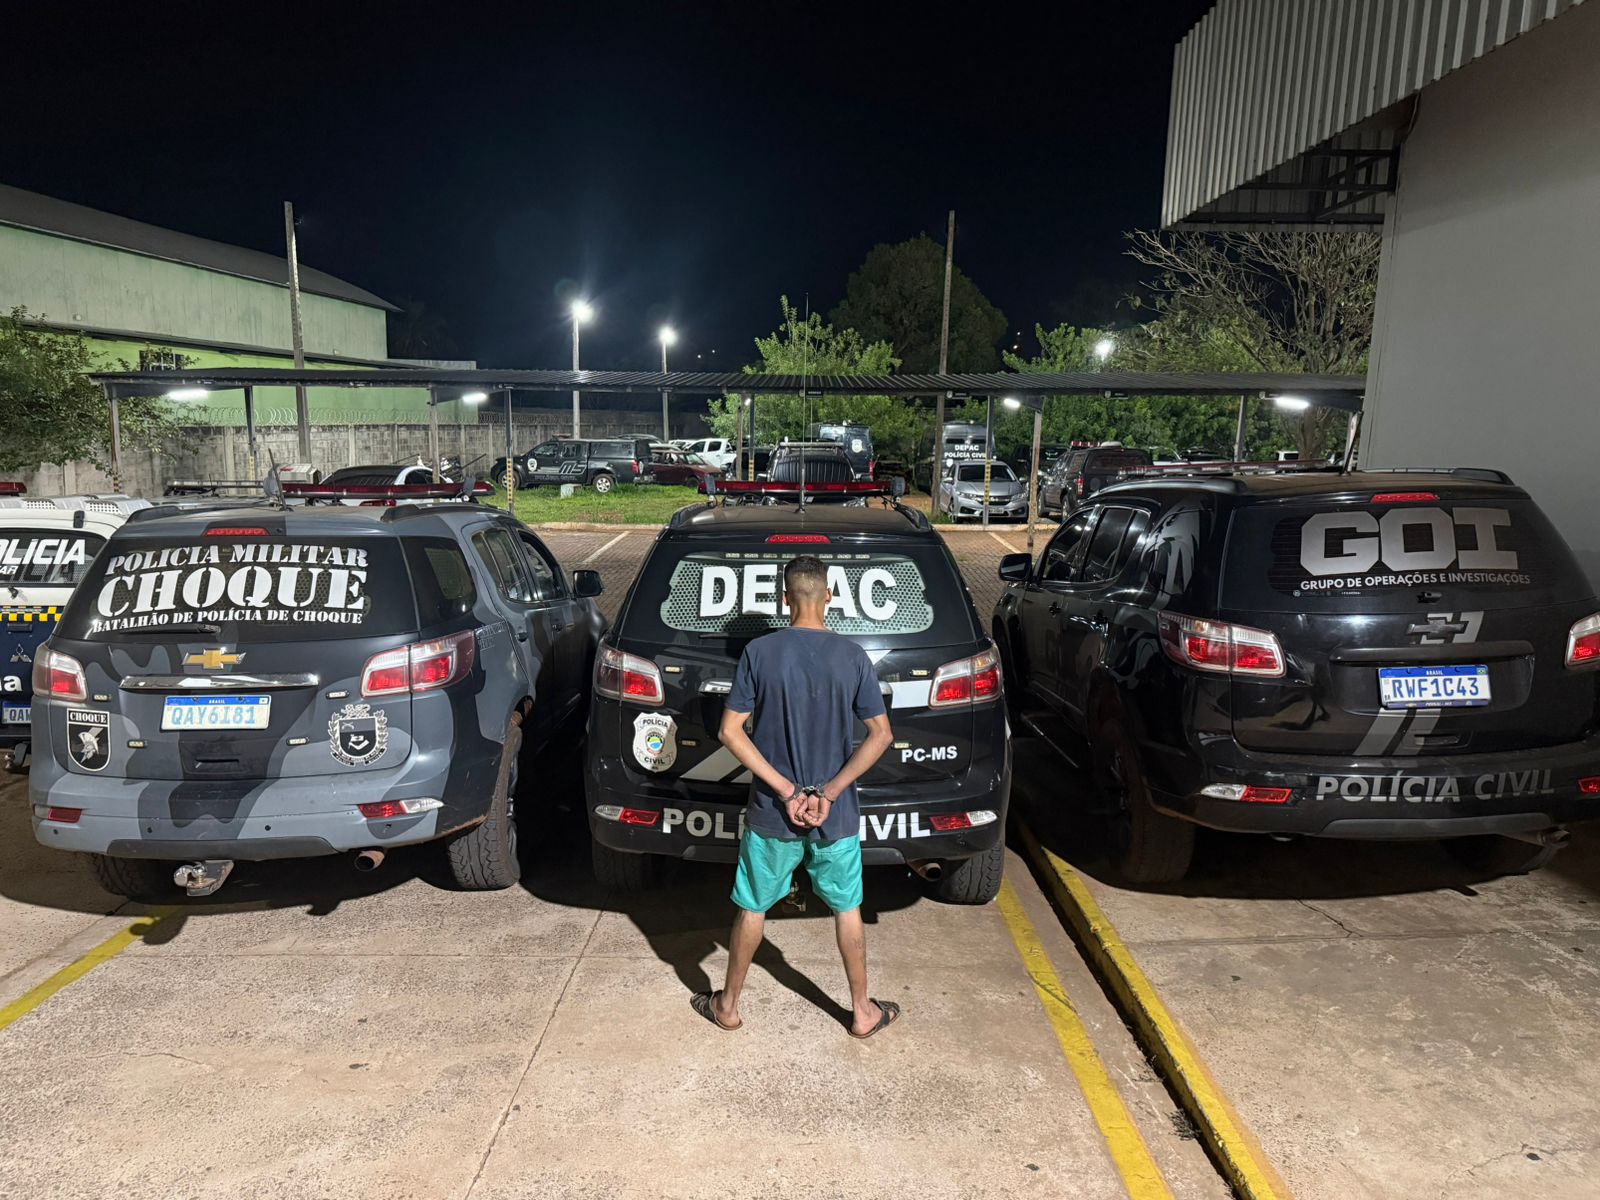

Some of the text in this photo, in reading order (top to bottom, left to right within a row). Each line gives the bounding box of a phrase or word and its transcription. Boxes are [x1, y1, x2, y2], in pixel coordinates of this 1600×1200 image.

[1300, 507, 1518, 576] GOI
[0, 565, 19, 575] AR
[104, 543, 369, 576] POLICIA MILITAR
[97, 565, 368, 617] CHOQUE
[1300, 572, 1531, 591] GRUPO DE OPERAÇÕES E INVESTIGAÇÕES
[700, 564, 898, 621] DEAC
[92, 607, 364, 633] BATALHÃO DE POLÍCIA DE CHOQUE
[1391, 677, 1479, 698] RWF1C43
[69, 711, 107, 724] CHOQUE
[171, 706, 256, 725] QAY6I81
[642, 718, 668, 728] POLÍCIA
[644, 756, 665, 764] CIVIL
[901, 745, 958, 763] PC-MS
[1316, 768, 1554, 803] POLÍCIA CIVIL
[859, 811, 931, 841] IVIL
